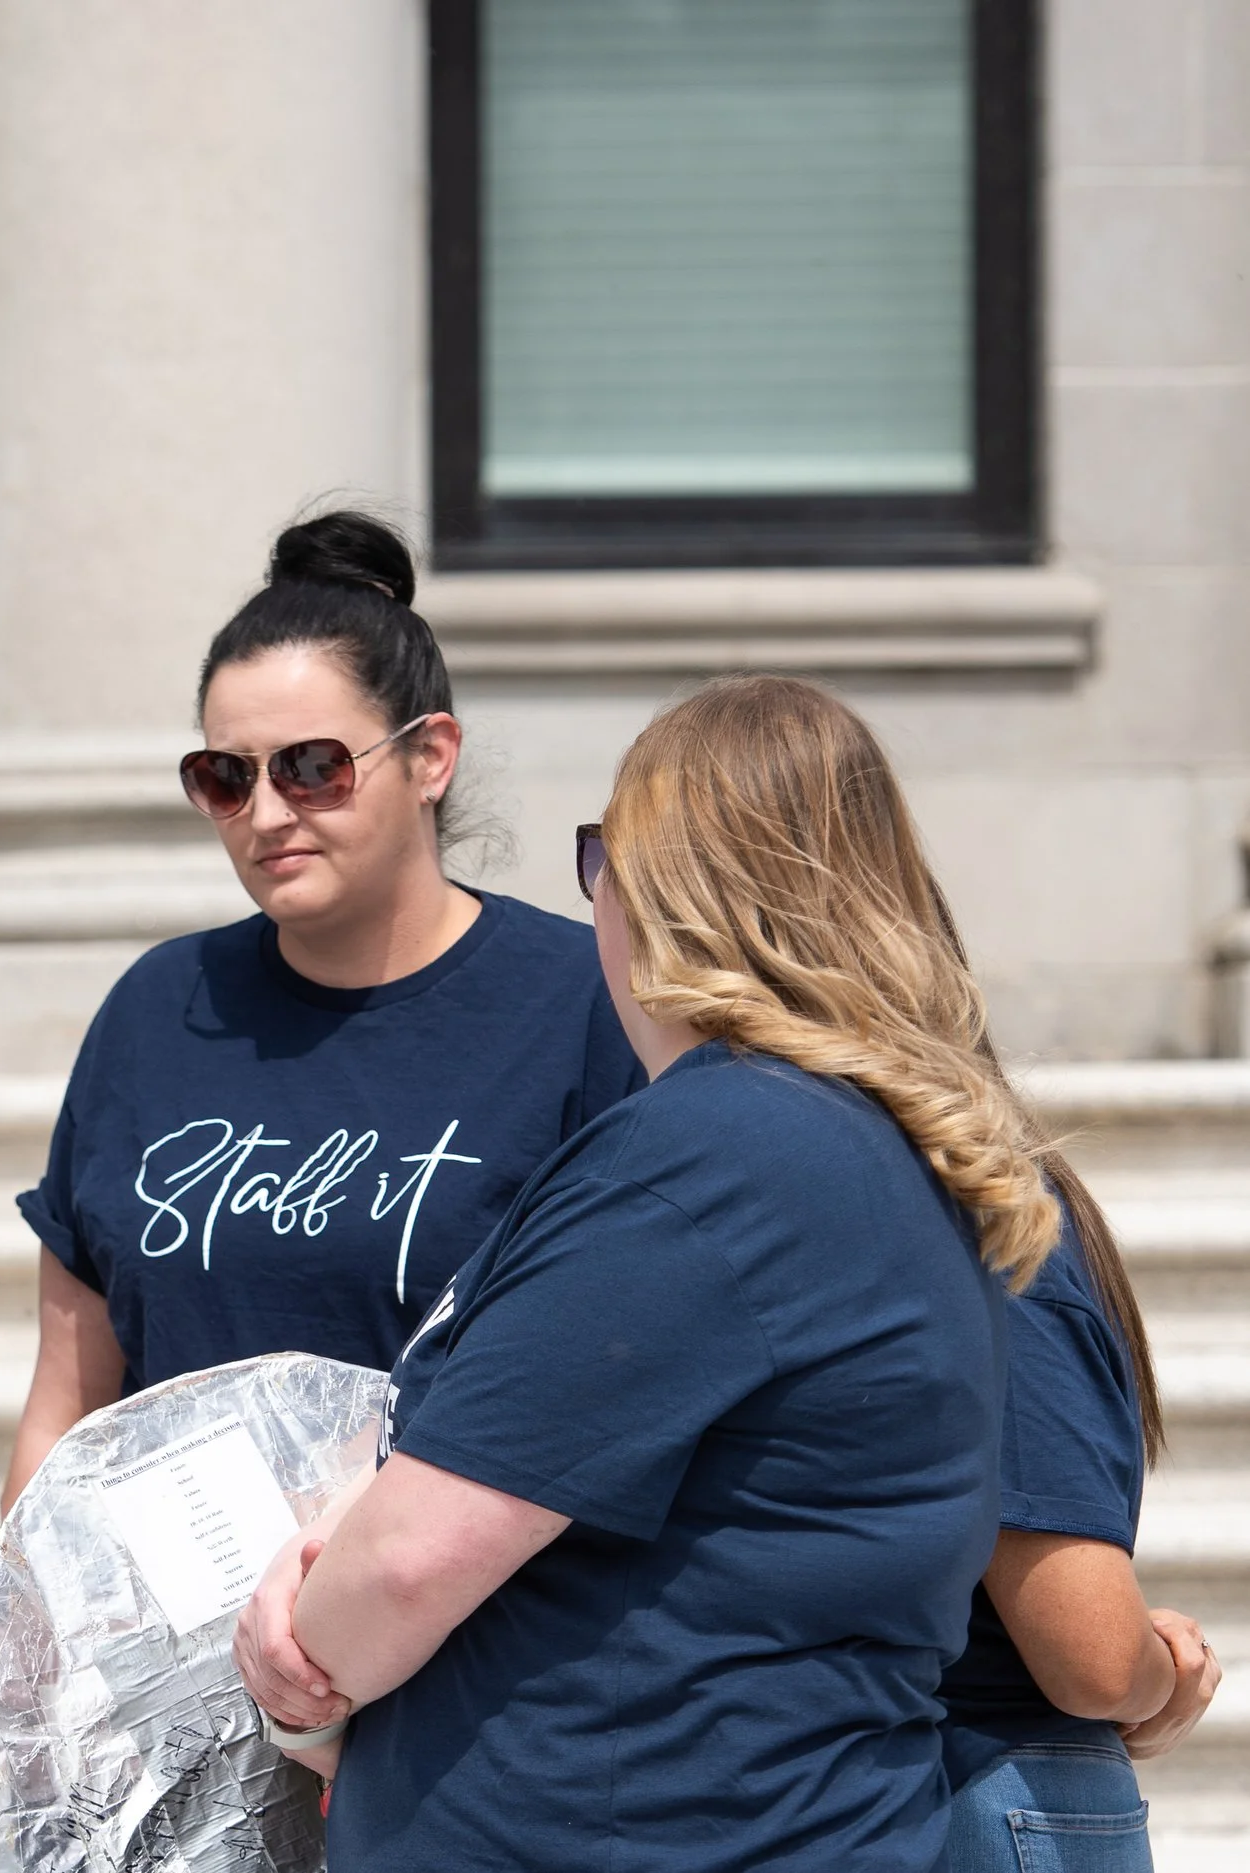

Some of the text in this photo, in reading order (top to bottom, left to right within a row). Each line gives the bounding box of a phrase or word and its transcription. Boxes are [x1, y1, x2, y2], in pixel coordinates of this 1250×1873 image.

[135, 1118, 482, 1304] Staff it
[101, 1475, 123, 1488] Things
[123, 1471, 131, 1480] to
[131, 1457, 160, 1475] consider
[161, 1449, 180, 1461] when
[180, 1437, 207, 1452] making
[212, 1420, 241, 1437] decision
